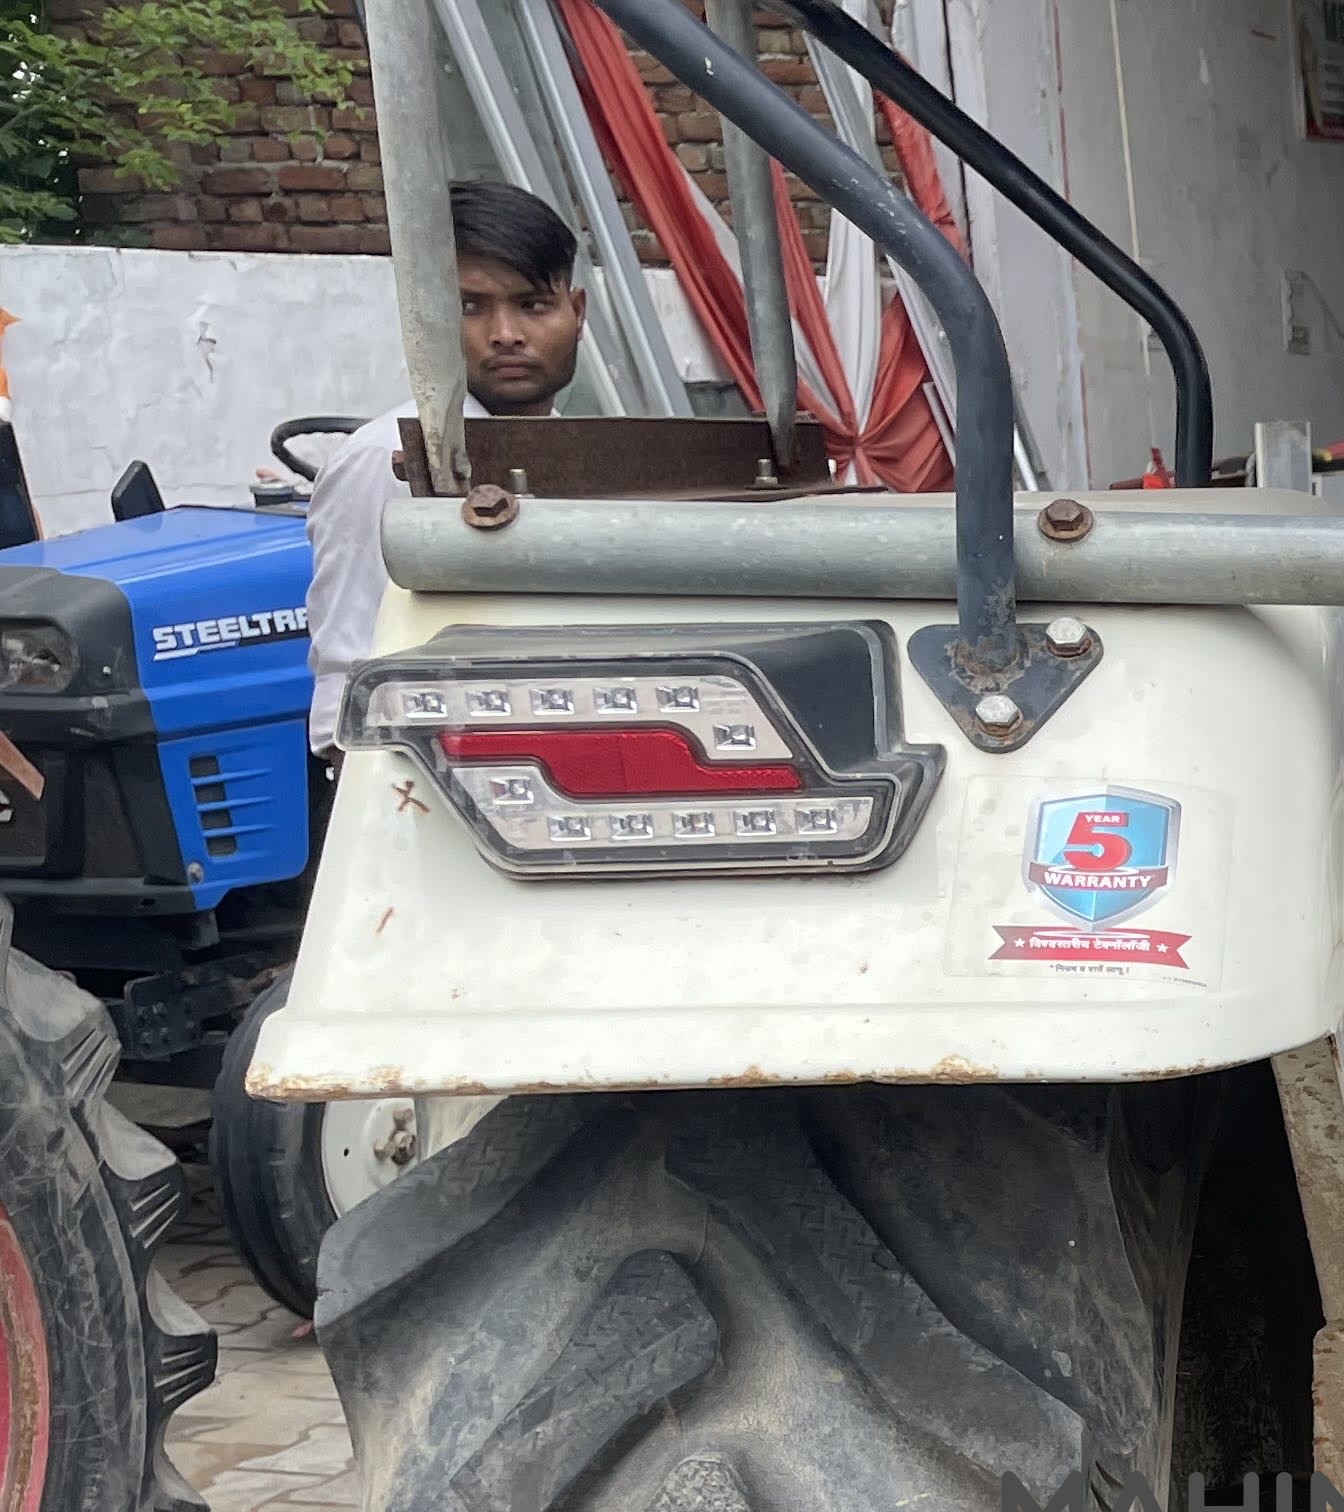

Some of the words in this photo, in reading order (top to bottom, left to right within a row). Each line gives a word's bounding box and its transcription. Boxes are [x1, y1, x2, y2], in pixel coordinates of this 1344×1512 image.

[1085, 814, 1121, 824] YEAR
[1063, 811, 1133, 872] 5
[1044, 871, 1152, 888] WARRANTY
